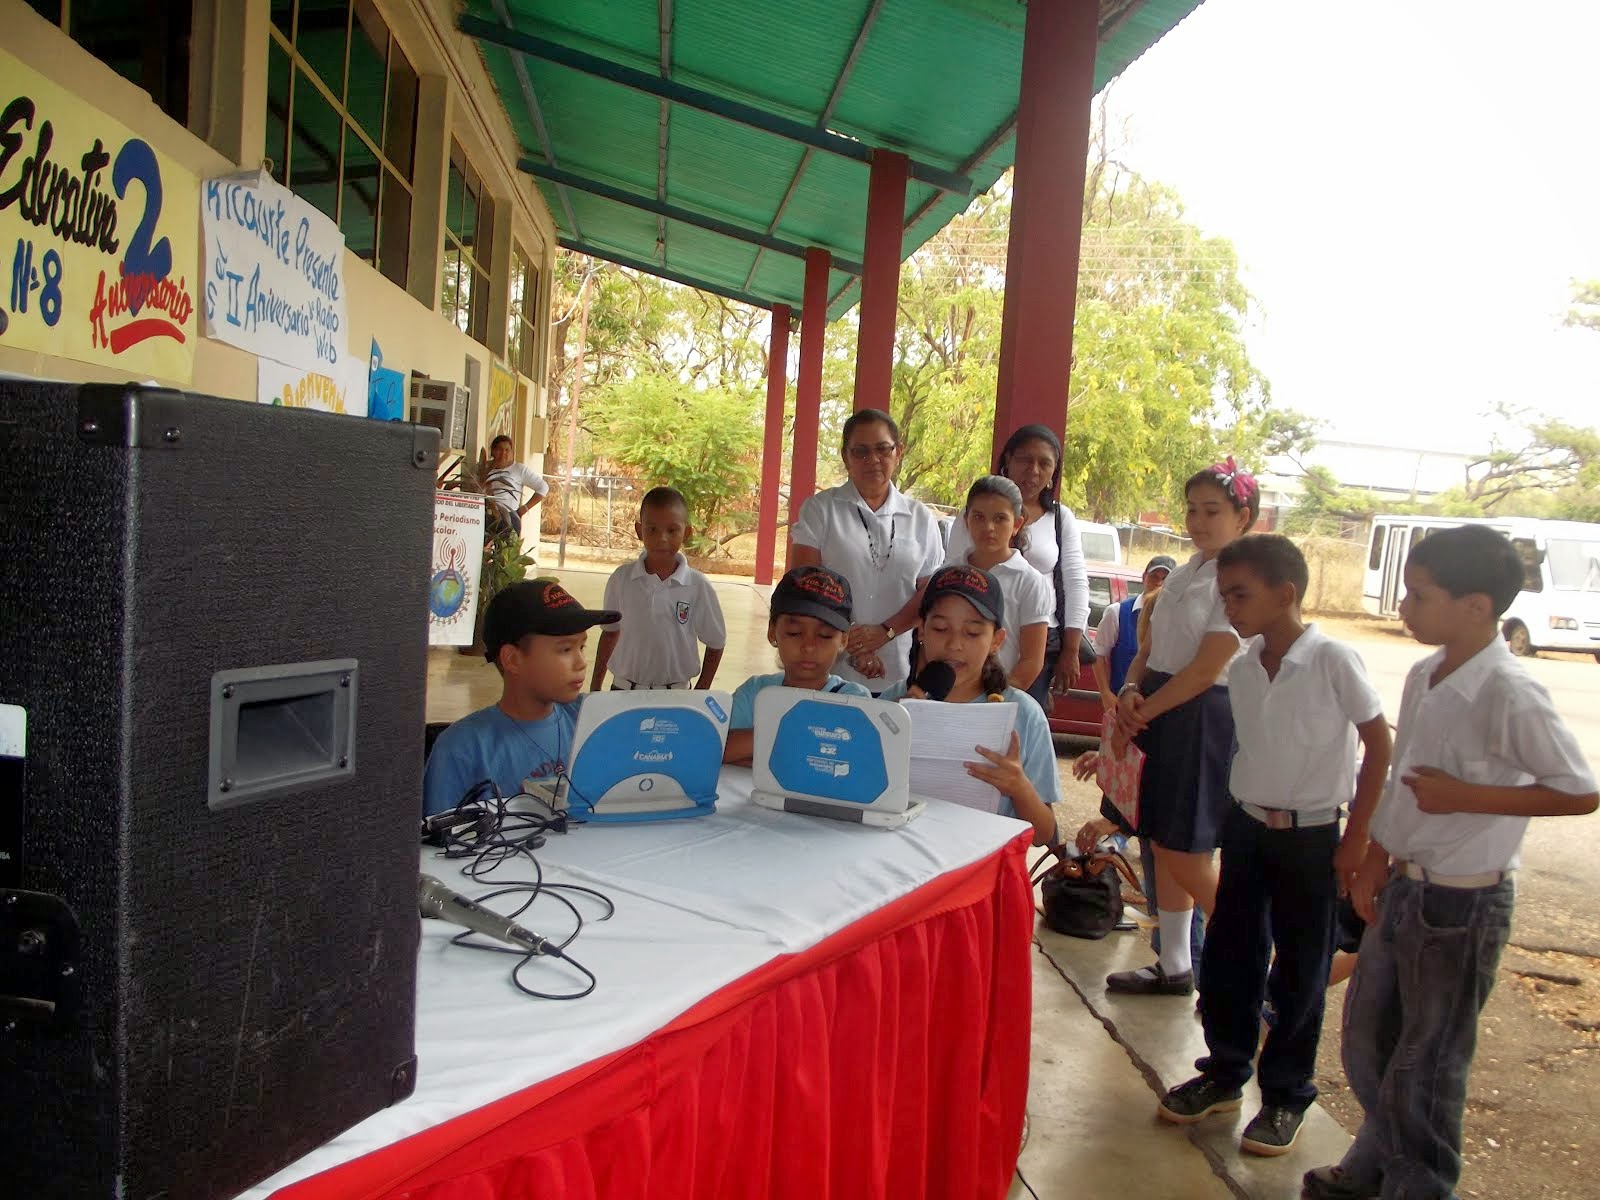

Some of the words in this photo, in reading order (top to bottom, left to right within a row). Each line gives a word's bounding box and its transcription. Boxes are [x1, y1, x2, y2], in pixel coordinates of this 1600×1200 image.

[113, 138, 172, 317] 2
[90, 260, 193, 349] Aniversario
[245, 262, 309, 336] Aniversario
[314, 324, 337, 364] Web
[440, 512, 481, 526] Periodismo
[455, 502, 480, 510] LIBERTADOR
